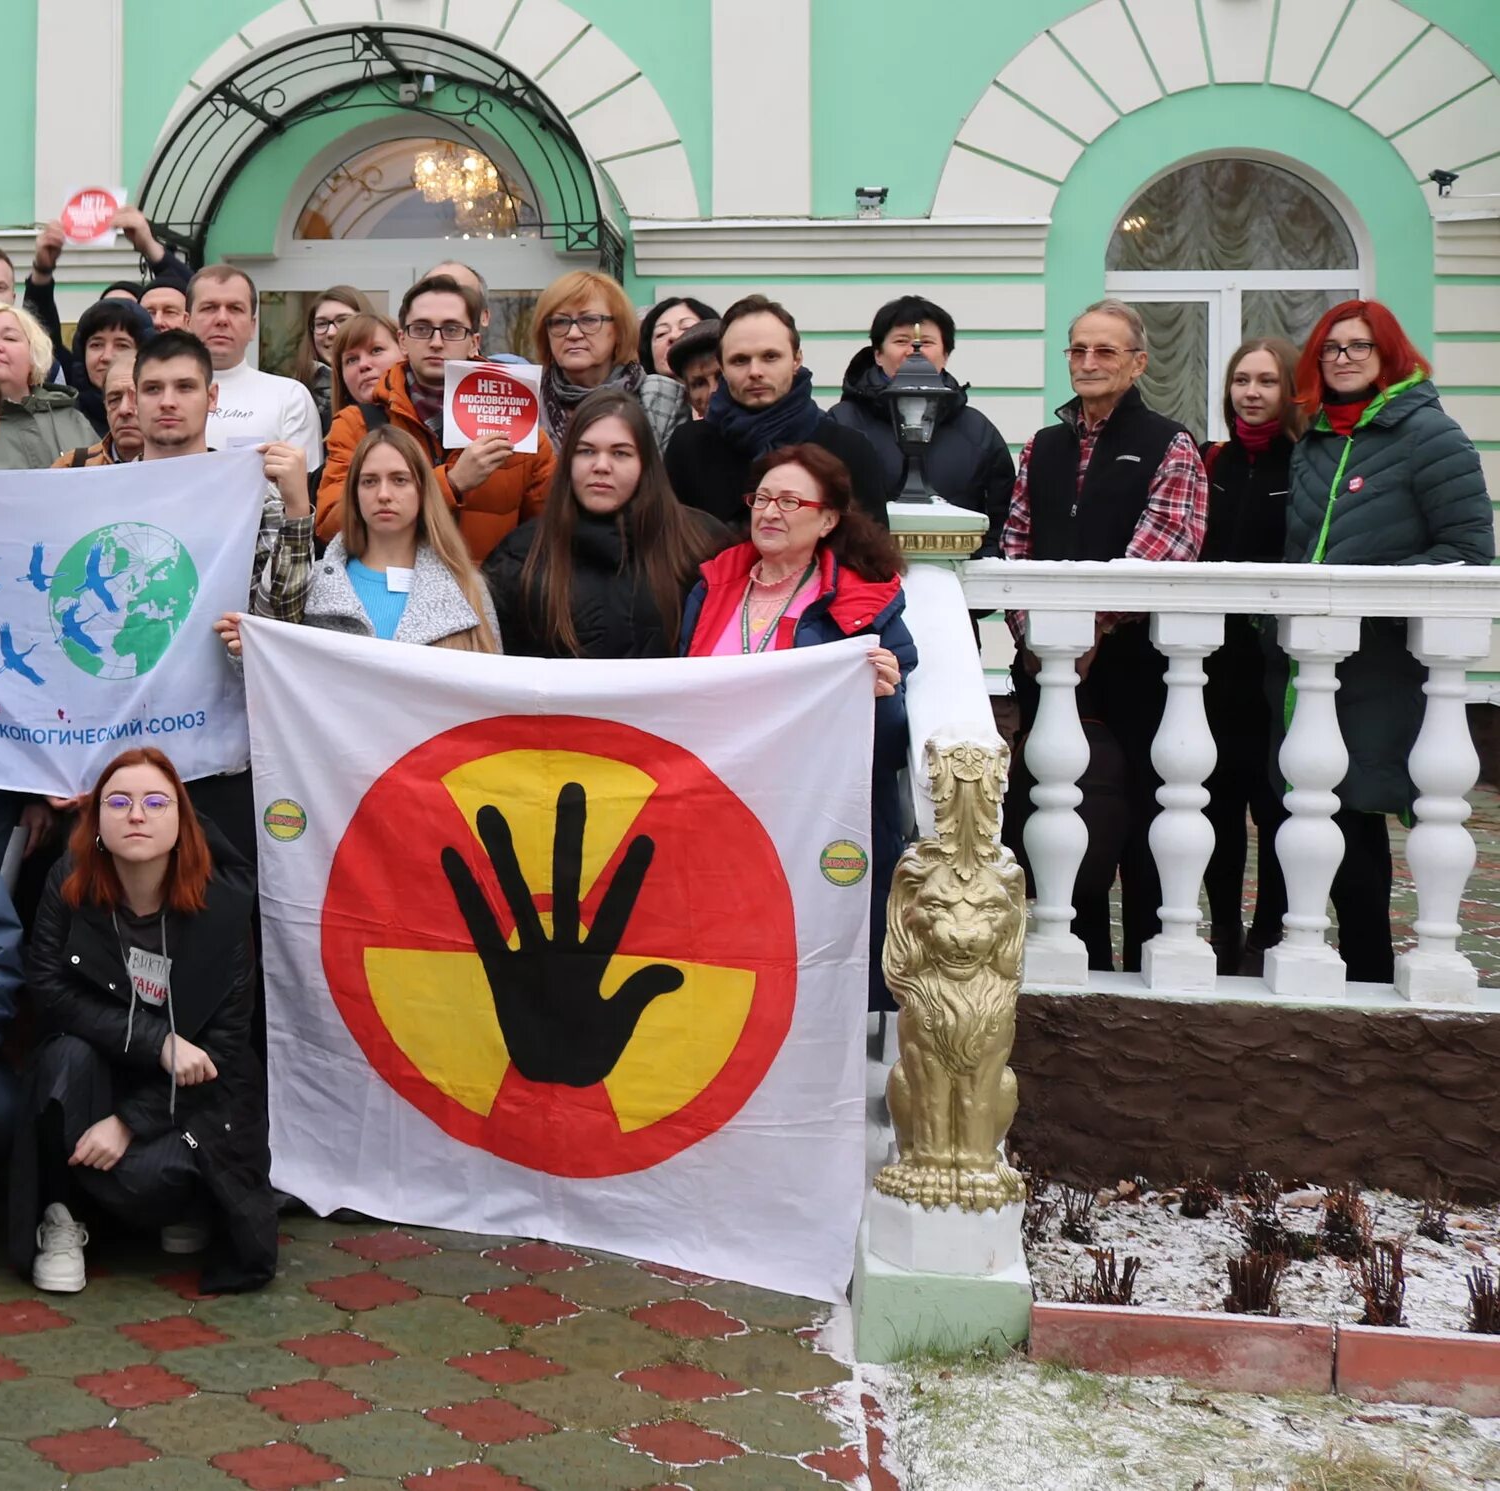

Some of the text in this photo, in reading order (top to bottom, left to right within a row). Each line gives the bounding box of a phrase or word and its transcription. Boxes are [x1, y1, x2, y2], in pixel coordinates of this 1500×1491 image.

[477, 379, 512, 395] НЕТ!
[460, 394, 530, 407] МОСКОВСКОМУ
[467, 405, 521, 416] МУСОРУ НА
[477, 415, 511, 425] СЕВЕРЕ
[149, 711, 205, 734] СОЮЗ
